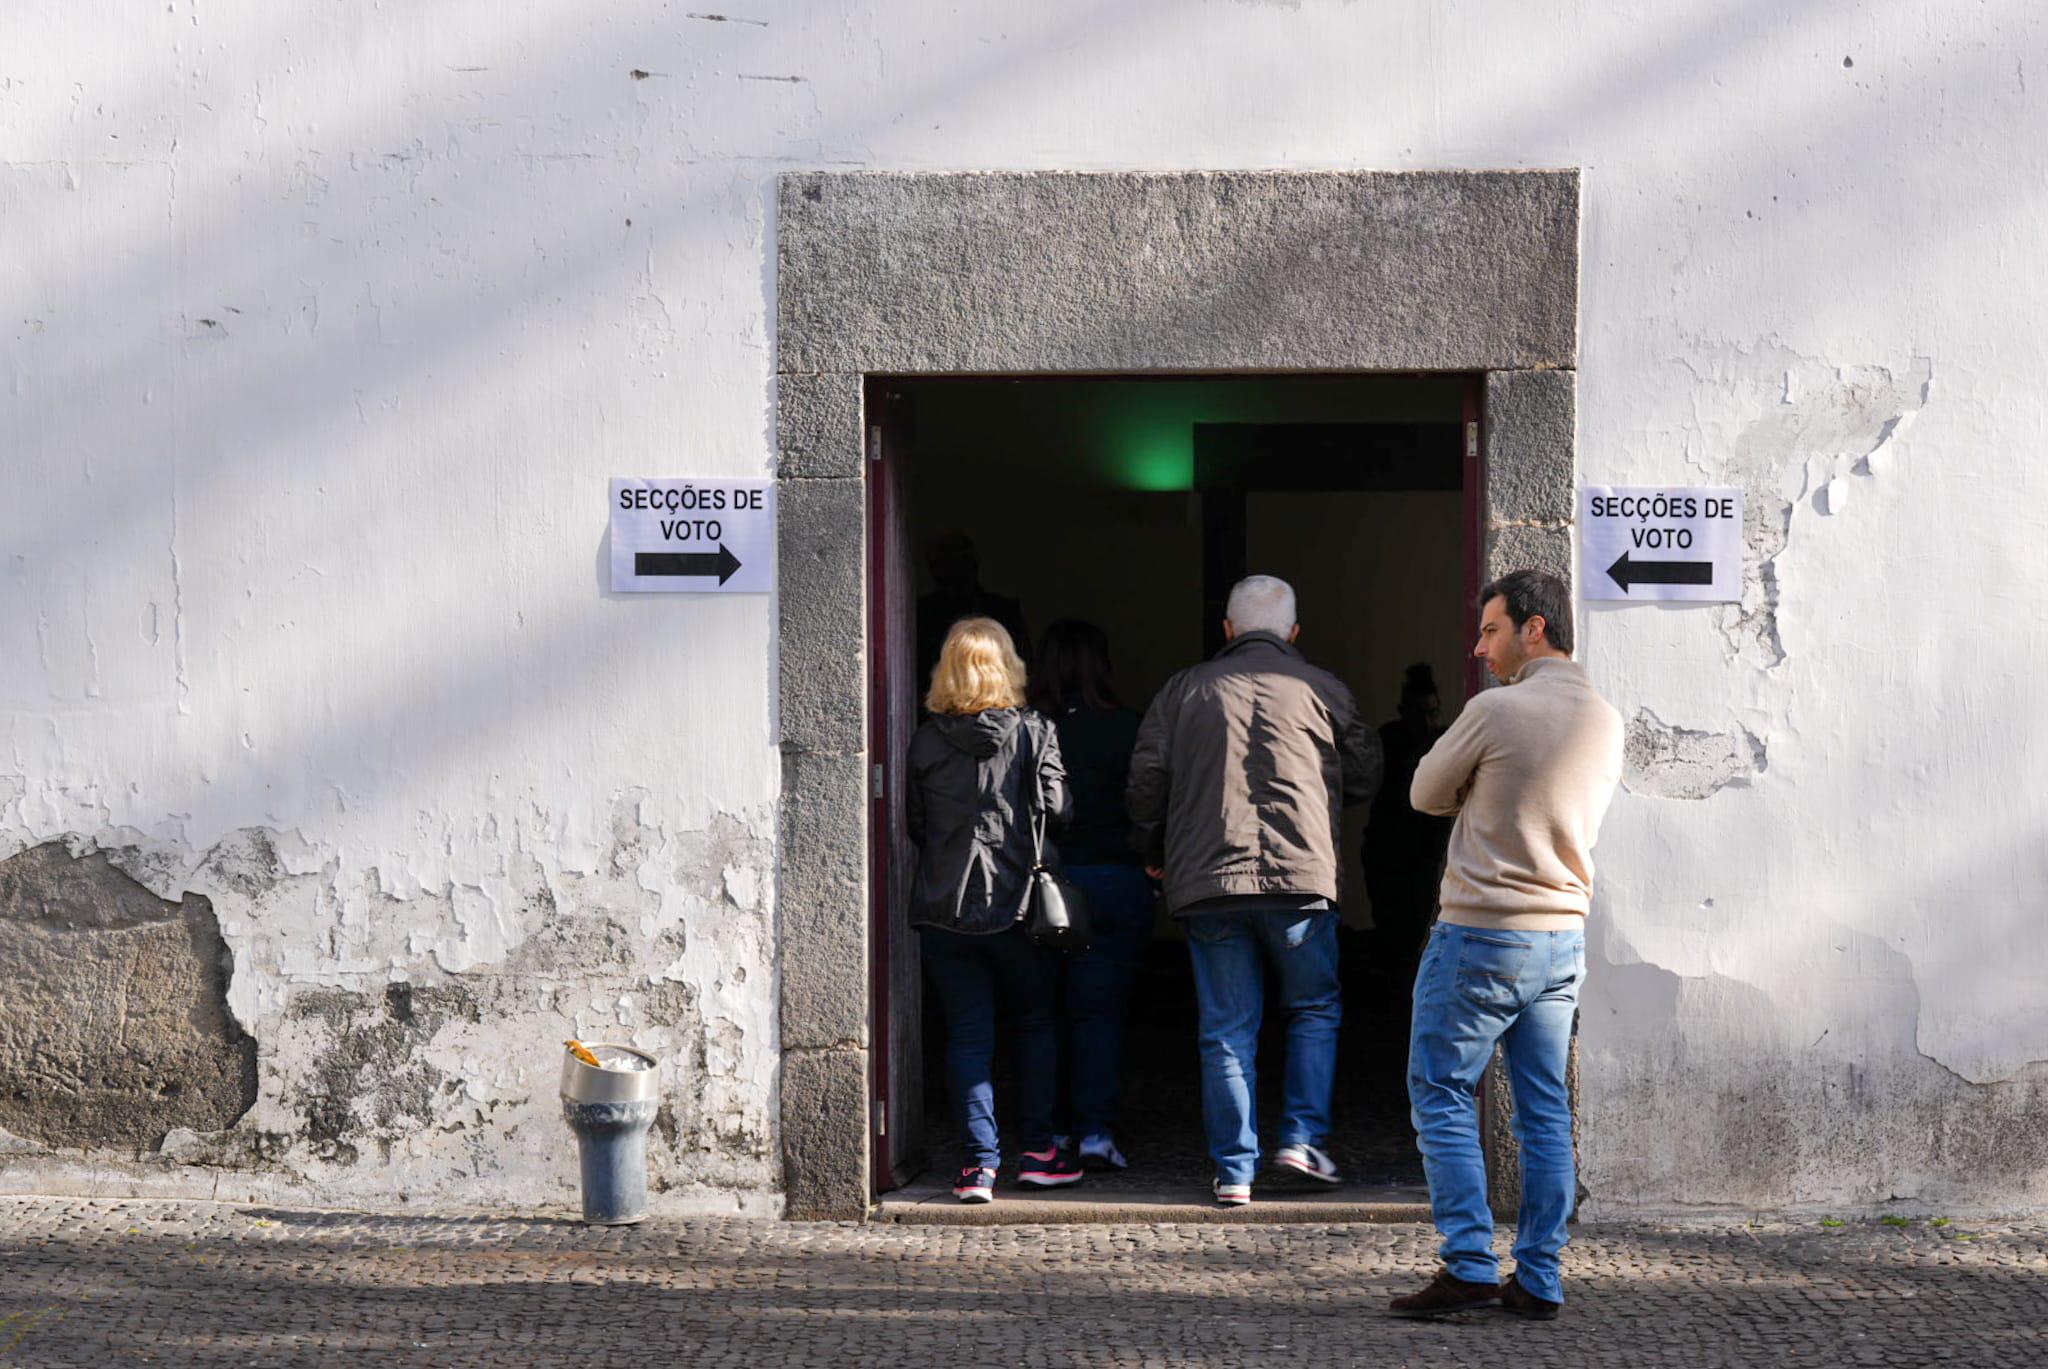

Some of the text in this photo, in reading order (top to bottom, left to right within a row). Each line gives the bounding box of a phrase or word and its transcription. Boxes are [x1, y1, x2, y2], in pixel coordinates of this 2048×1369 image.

[620, 485, 762, 515] SECÇÕES DE
[1591, 493, 1733, 523] SECÇÕES DE
[661, 520, 721, 540] VOTO
[1632, 528, 1692, 549] VOTO
